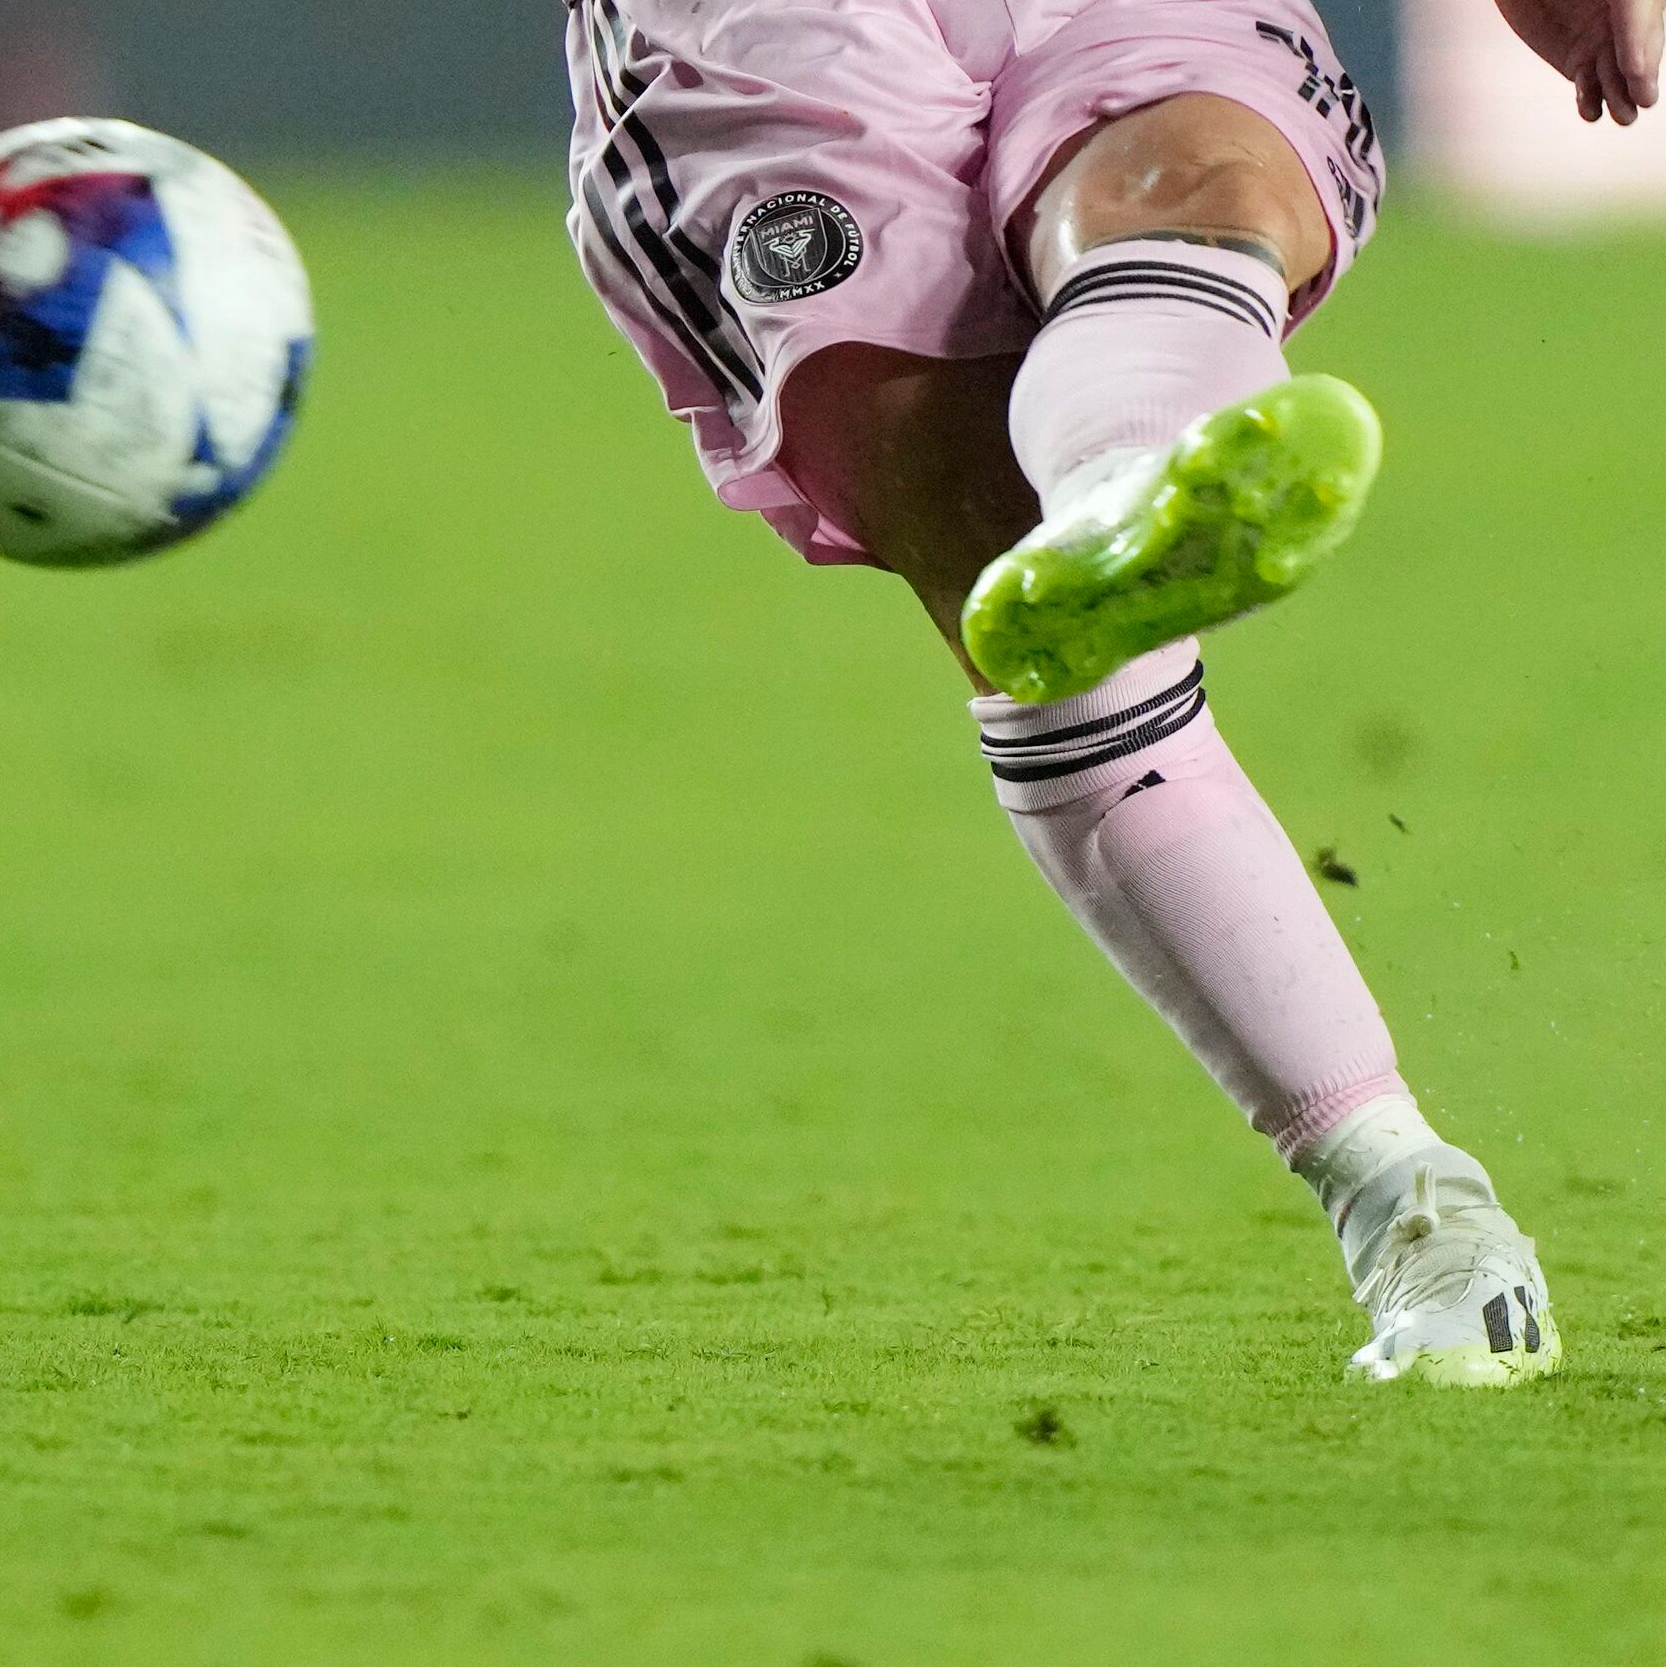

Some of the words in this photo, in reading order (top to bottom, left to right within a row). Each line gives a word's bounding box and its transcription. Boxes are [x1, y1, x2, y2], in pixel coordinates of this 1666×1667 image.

[830, 205, 847, 221] DE
[760, 216, 813, 239] MIAMI
[779, 281, 825, 299] MMXX
